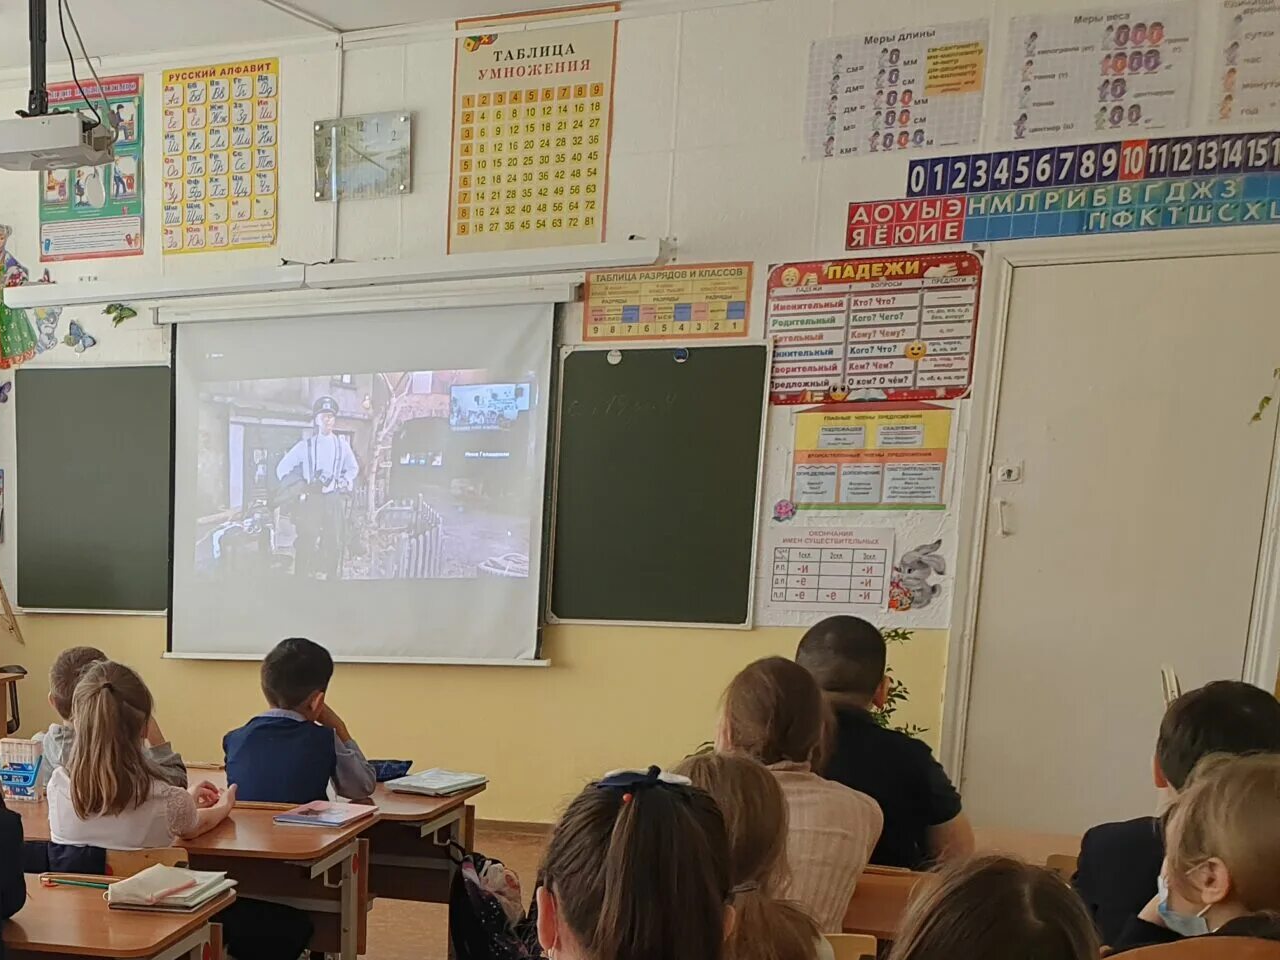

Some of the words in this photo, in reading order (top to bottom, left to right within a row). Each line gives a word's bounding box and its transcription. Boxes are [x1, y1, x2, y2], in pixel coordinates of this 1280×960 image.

[1074, 15, 1103, 24] Меры
[864, 36, 896, 45] Меры
[898, 30, 935, 42] длины
[493, 43, 575, 61] ТАБЛИЦА
[169, 69, 216, 81] РУССКИЙ
[220, 63, 271, 75] АЛФАВИТ
[478, 59, 591, 80] УМНОЖЕНИЯ
[527, 108, 535, 116] 10
[543, 106, 551, 115] 12
[559, 105, 567, 113] 14
[575, 104, 584, 112] 16
[591, 102, 600, 111] 18
[510, 125, 519, 134] 12
[526, 124, 534, 132] 15
[542, 123, 550, 131] 18
[558, 122, 566, 130] 21
[573, 120, 583, 129] 24
[589, 118, 600, 127] 27
[494, 143, 502, 151] 12
[510, 142, 518, 150] 16
[524, 140, 534, 149] 20
[540, 139, 549, 147] 24
[556, 138, 566, 146] 28
[573, 136, 582, 145] 32
[589, 135, 598, 144] 36
[911, 166, 924, 193] 0
[934, 164, 944, 190] 1
[952, 162, 967, 189] 2
[973, 160, 987, 187] 3
[994, 158, 1009, 184] 4
[1015, 156, 1030, 183] 5
[1036, 154, 1050, 181] 6
[1059, 152, 1074, 180] 7
[1080, 150, 1095, 178] 8
[1102, 149, 1117, 176] 9
[1123, 146, 1143, 174] 10
[1149, 145, 1168, 173] 11
[1172, 143, 1193, 171] 12
[1197, 142, 1217, 169] 13
[1222, 140, 1241, 168] 14
[1247, 138, 1268, 166] 15
[595, 273, 637, 282] ТАБЛИЦА
[639, 271, 687, 280] РАЗРЯДОВ
[699, 269, 743, 277] КЛАССОВ
[828, 260, 920, 280] ПАДЕЖИ
[773, 301, 844, 311] Именительный
[853, 298, 872, 307] Кто?
[876, 297, 895, 305] Что?
[772, 317, 836, 327] Родительный
[852, 314, 876, 322] Кого?
[880, 312, 904, 320] Чего?
[851, 330, 876, 339] Кому?
[880, 329, 905, 338] Чему?
[850, 346, 874, 354] Кого?
[877, 345, 897, 353] Что?
[849, 362, 870, 370] Кем?
[873, 361, 894, 369] Чем?
